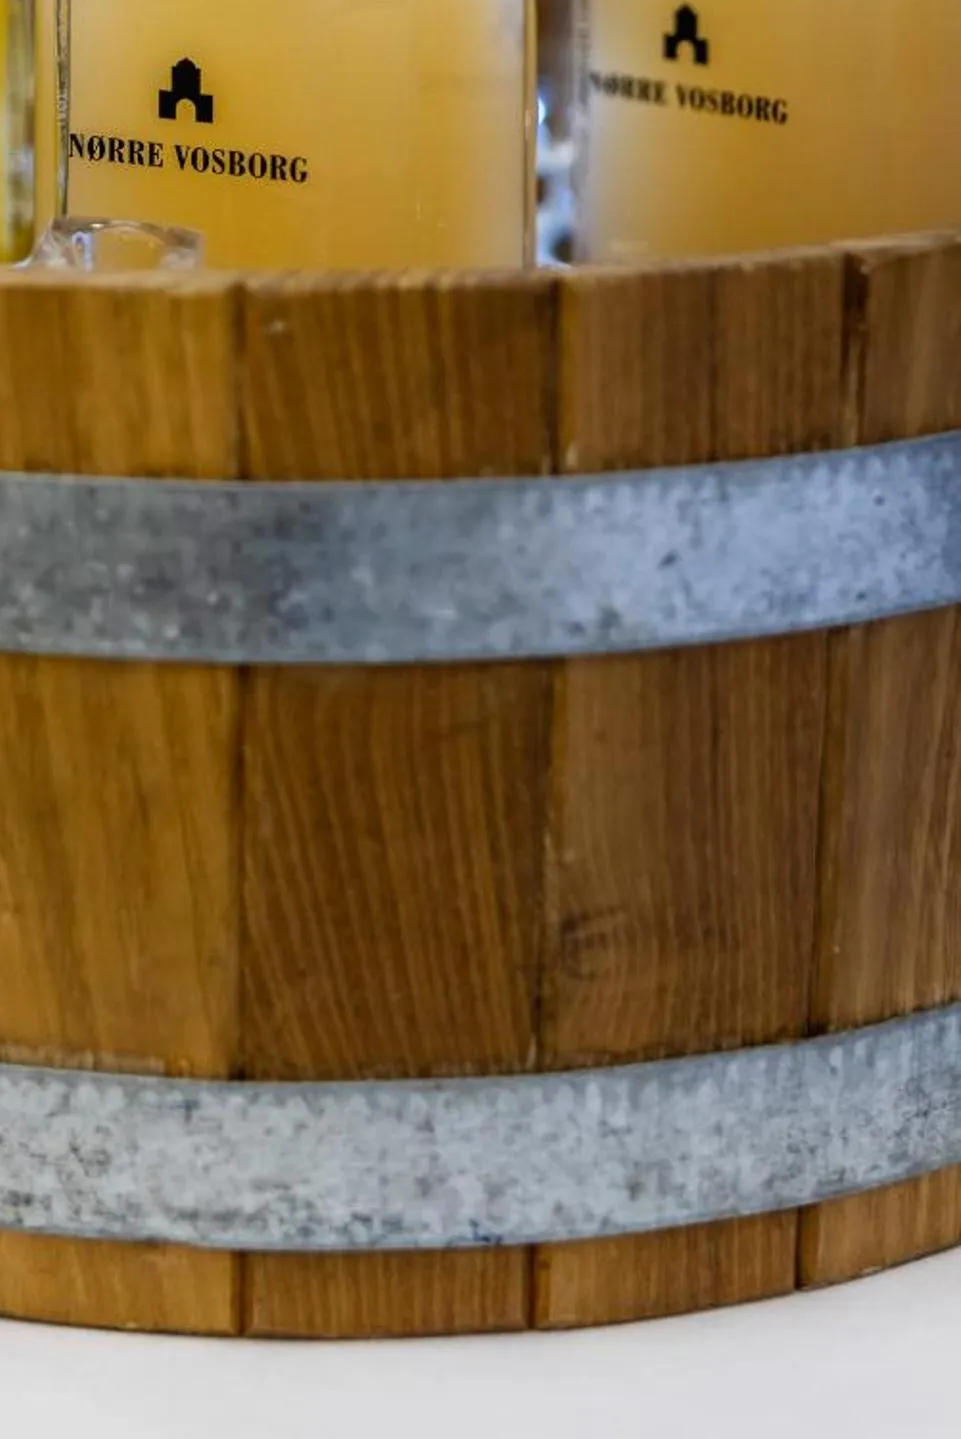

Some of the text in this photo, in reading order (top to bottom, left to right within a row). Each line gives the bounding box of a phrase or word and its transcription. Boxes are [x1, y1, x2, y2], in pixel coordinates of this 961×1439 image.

[675, 83, 788, 126] VOSBORG
[68, 133, 309, 184] NØRRE VOSBORG
